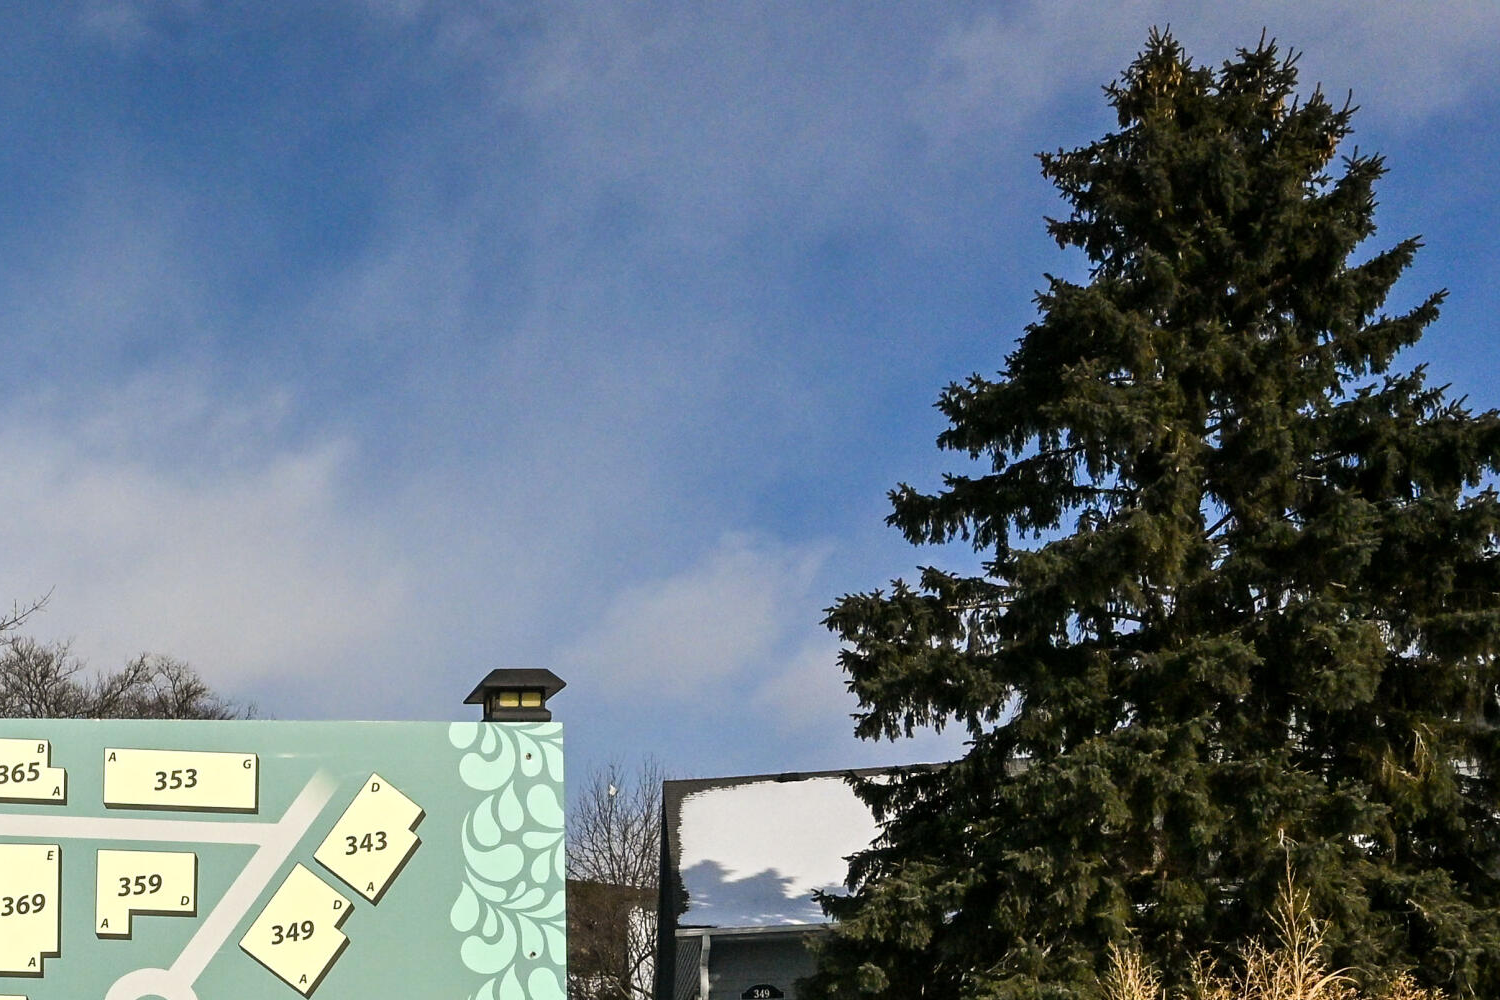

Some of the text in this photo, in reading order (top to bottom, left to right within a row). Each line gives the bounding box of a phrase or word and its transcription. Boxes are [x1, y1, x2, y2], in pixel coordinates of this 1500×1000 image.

[36, 743, 45, 754] B
[107, 751, 117, 762] A
[242, 759, 252, 770] G
[154, 768, 198, 791] 353
[51, 785, 61, 797] A
[370, 781, 381, 793] D
[345, 830, 388, 856] 343
[46, 850, 55, 861] E
[117, 873, 163, 897] 359
[365, 881, 375, 892] A
[0, 893, 46, 917] 369
[180, 895, 190, 906] D
[332, 899, 343, 910] D
[100, 918, 109, 929] A
[271, 920, 315, 945] 349
[27, 956, 37, 968] A
[298, 973, 308, 984] A
[753, 989, 770, 999] 349
